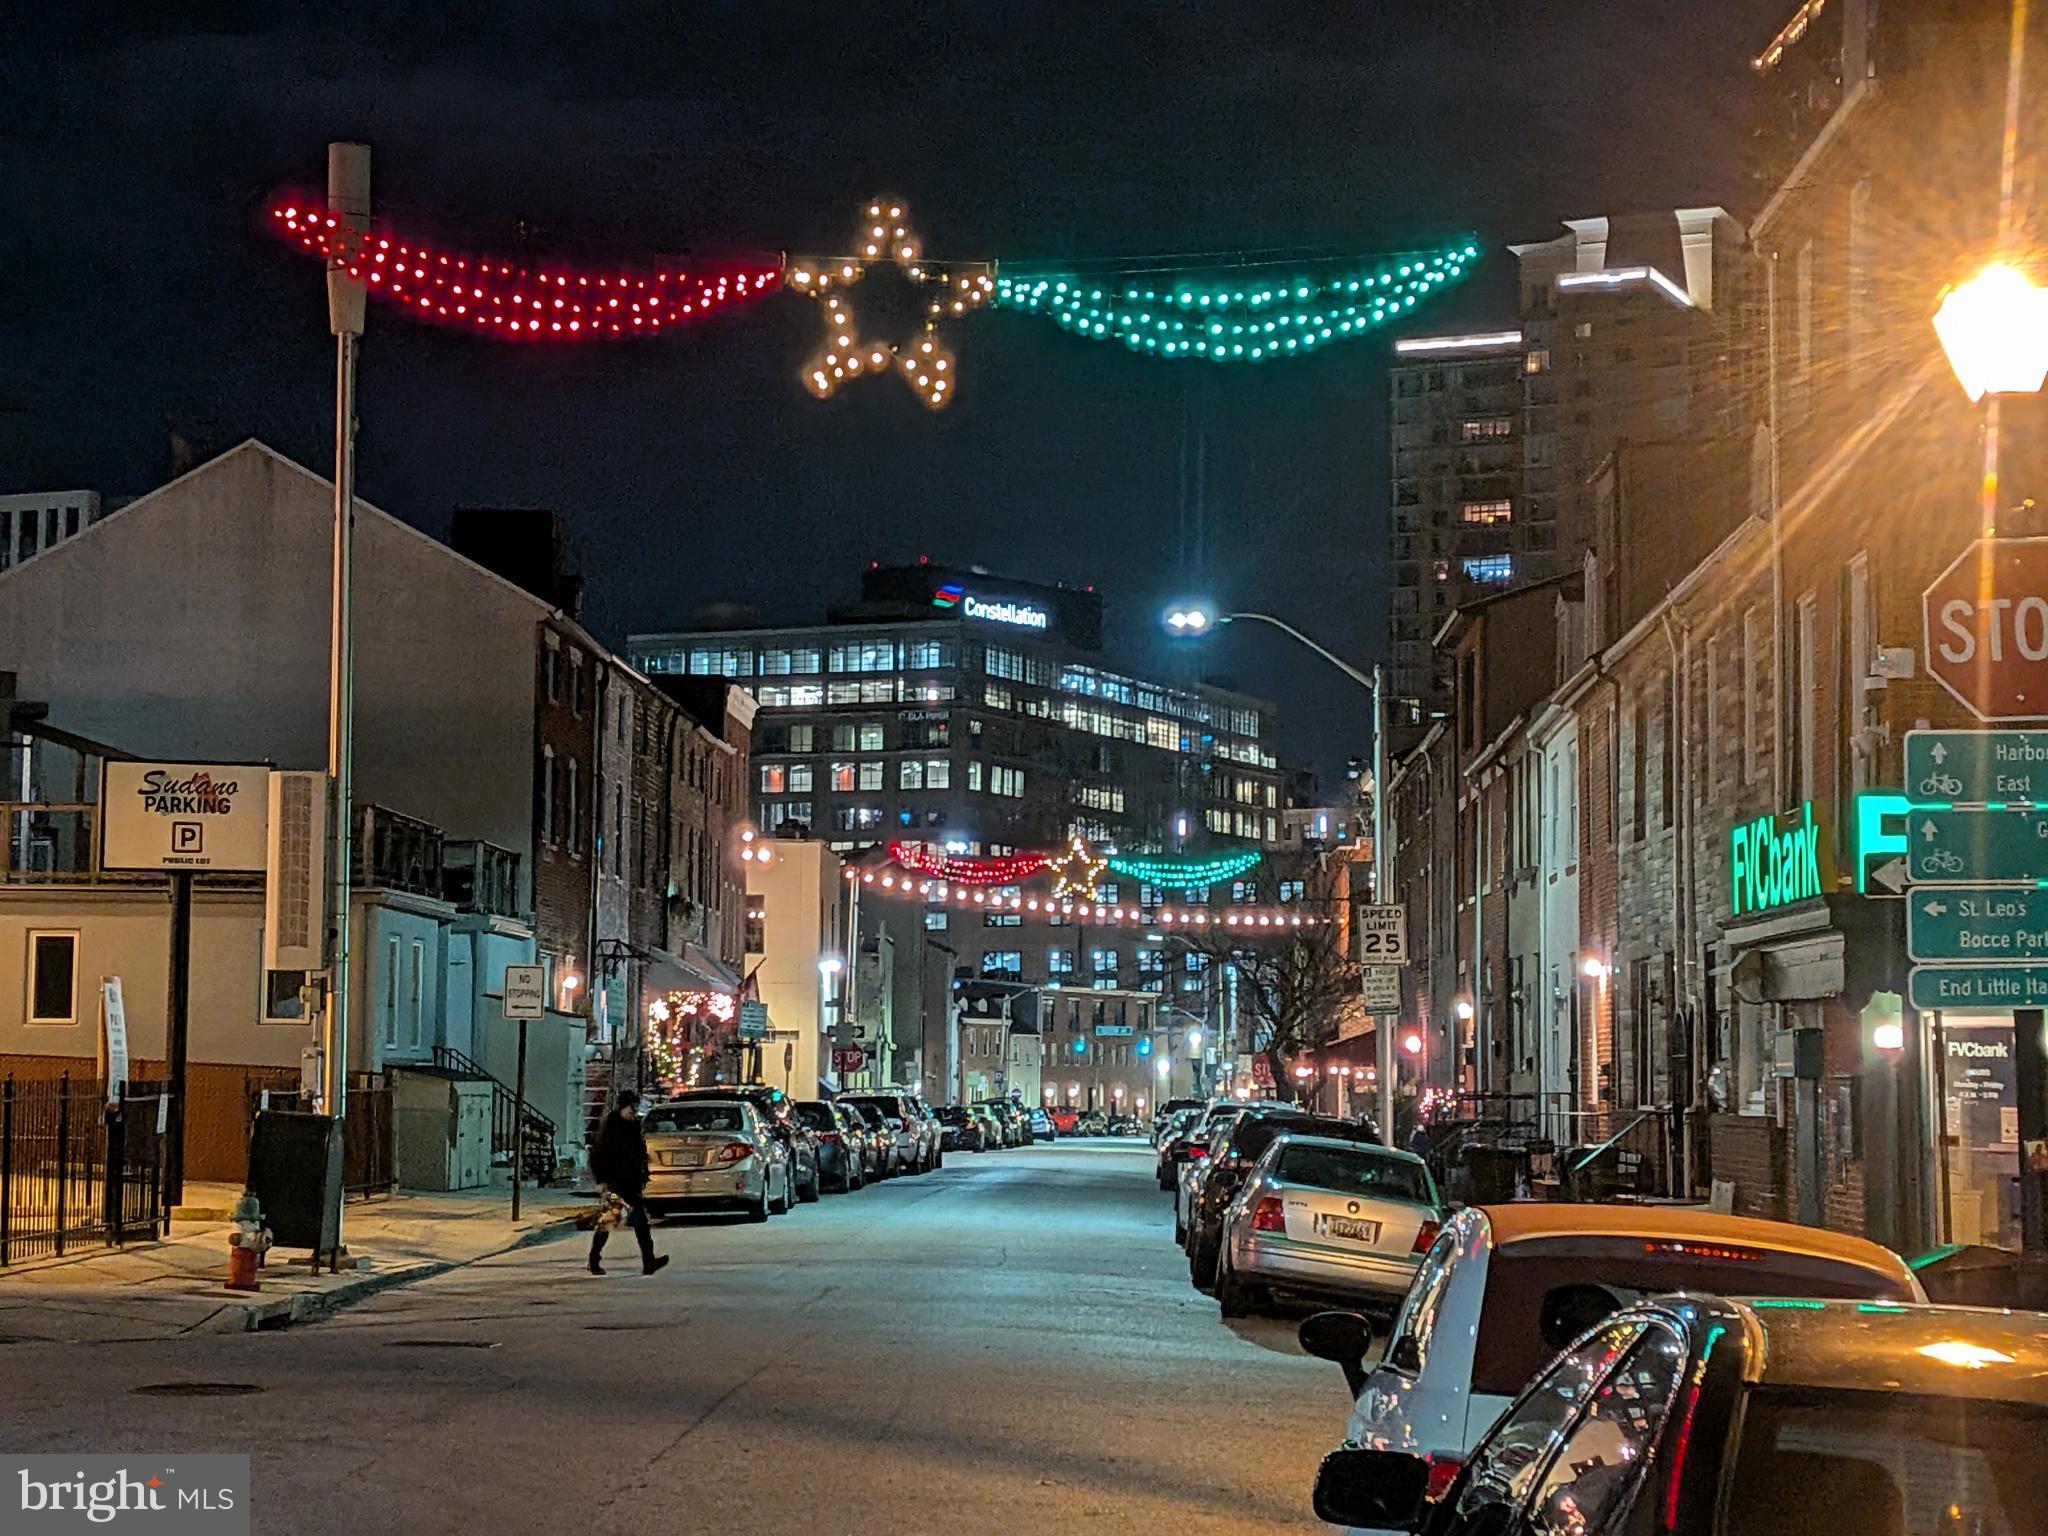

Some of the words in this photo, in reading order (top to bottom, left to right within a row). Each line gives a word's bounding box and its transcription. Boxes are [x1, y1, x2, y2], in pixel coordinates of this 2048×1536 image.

[964, 597, 1046, 628] Constellation
[137, 770, 239, 796] Sudano
[1996, 774, 2031, 792] East
[144, 796, 232, 815] PARKING
[1732, 800, 1822, 915] FVCbank
[1361, 909, 1402, 919] SPEED
[1366, 921, 1397, 931] LIMIT
[1365, 933, 1401, 954] 25
[1960, 930, 2010, 949] Bocce
[519, 974, 531, 984] NO
[1940, 979, 1972, 997] End
[1977, 977, 2021, 996] Little
[1947, 1041, 2009, 1058] FVCbank
